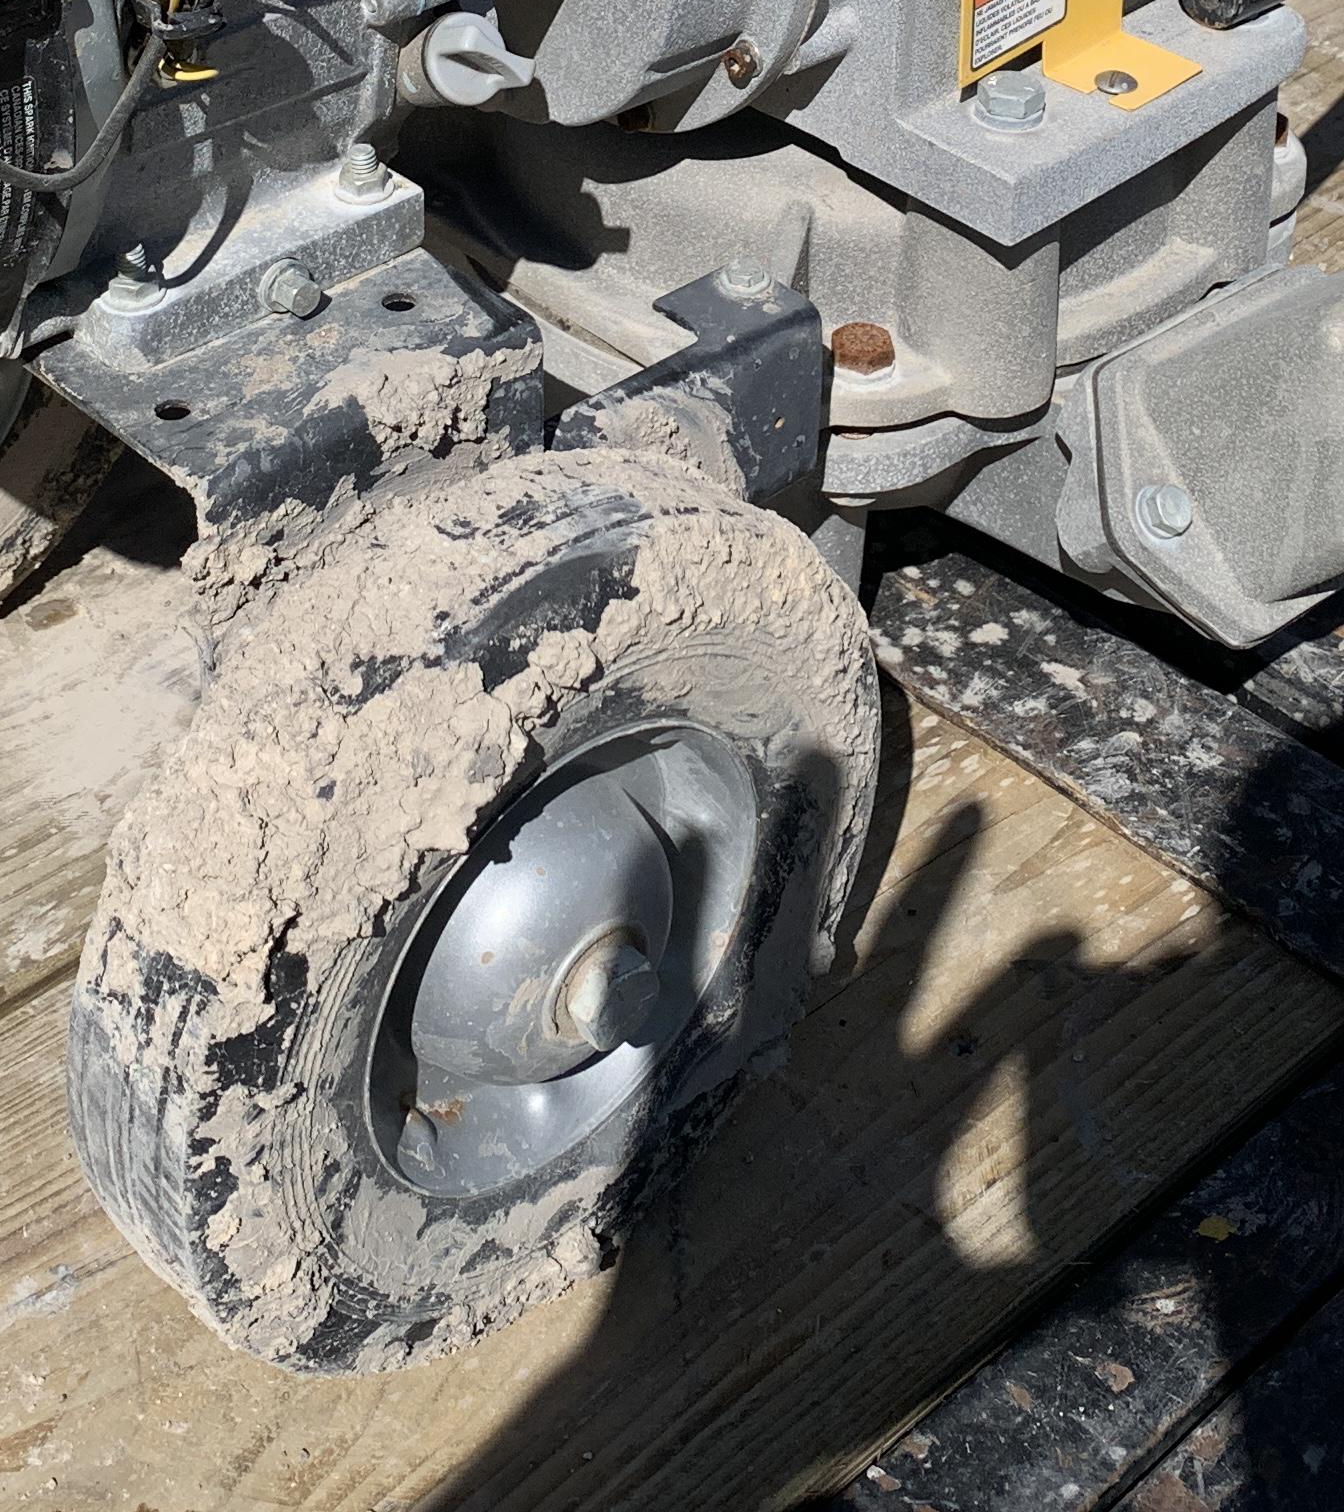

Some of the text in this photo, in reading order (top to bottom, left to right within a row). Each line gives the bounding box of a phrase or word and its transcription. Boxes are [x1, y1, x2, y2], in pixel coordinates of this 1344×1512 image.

[0, 89, 10, 103] CE
[22, 81, 33, 103] THIS
[11, 85, 23, 134] CANADIAN
[24, 104, 35, 135] SPARK
